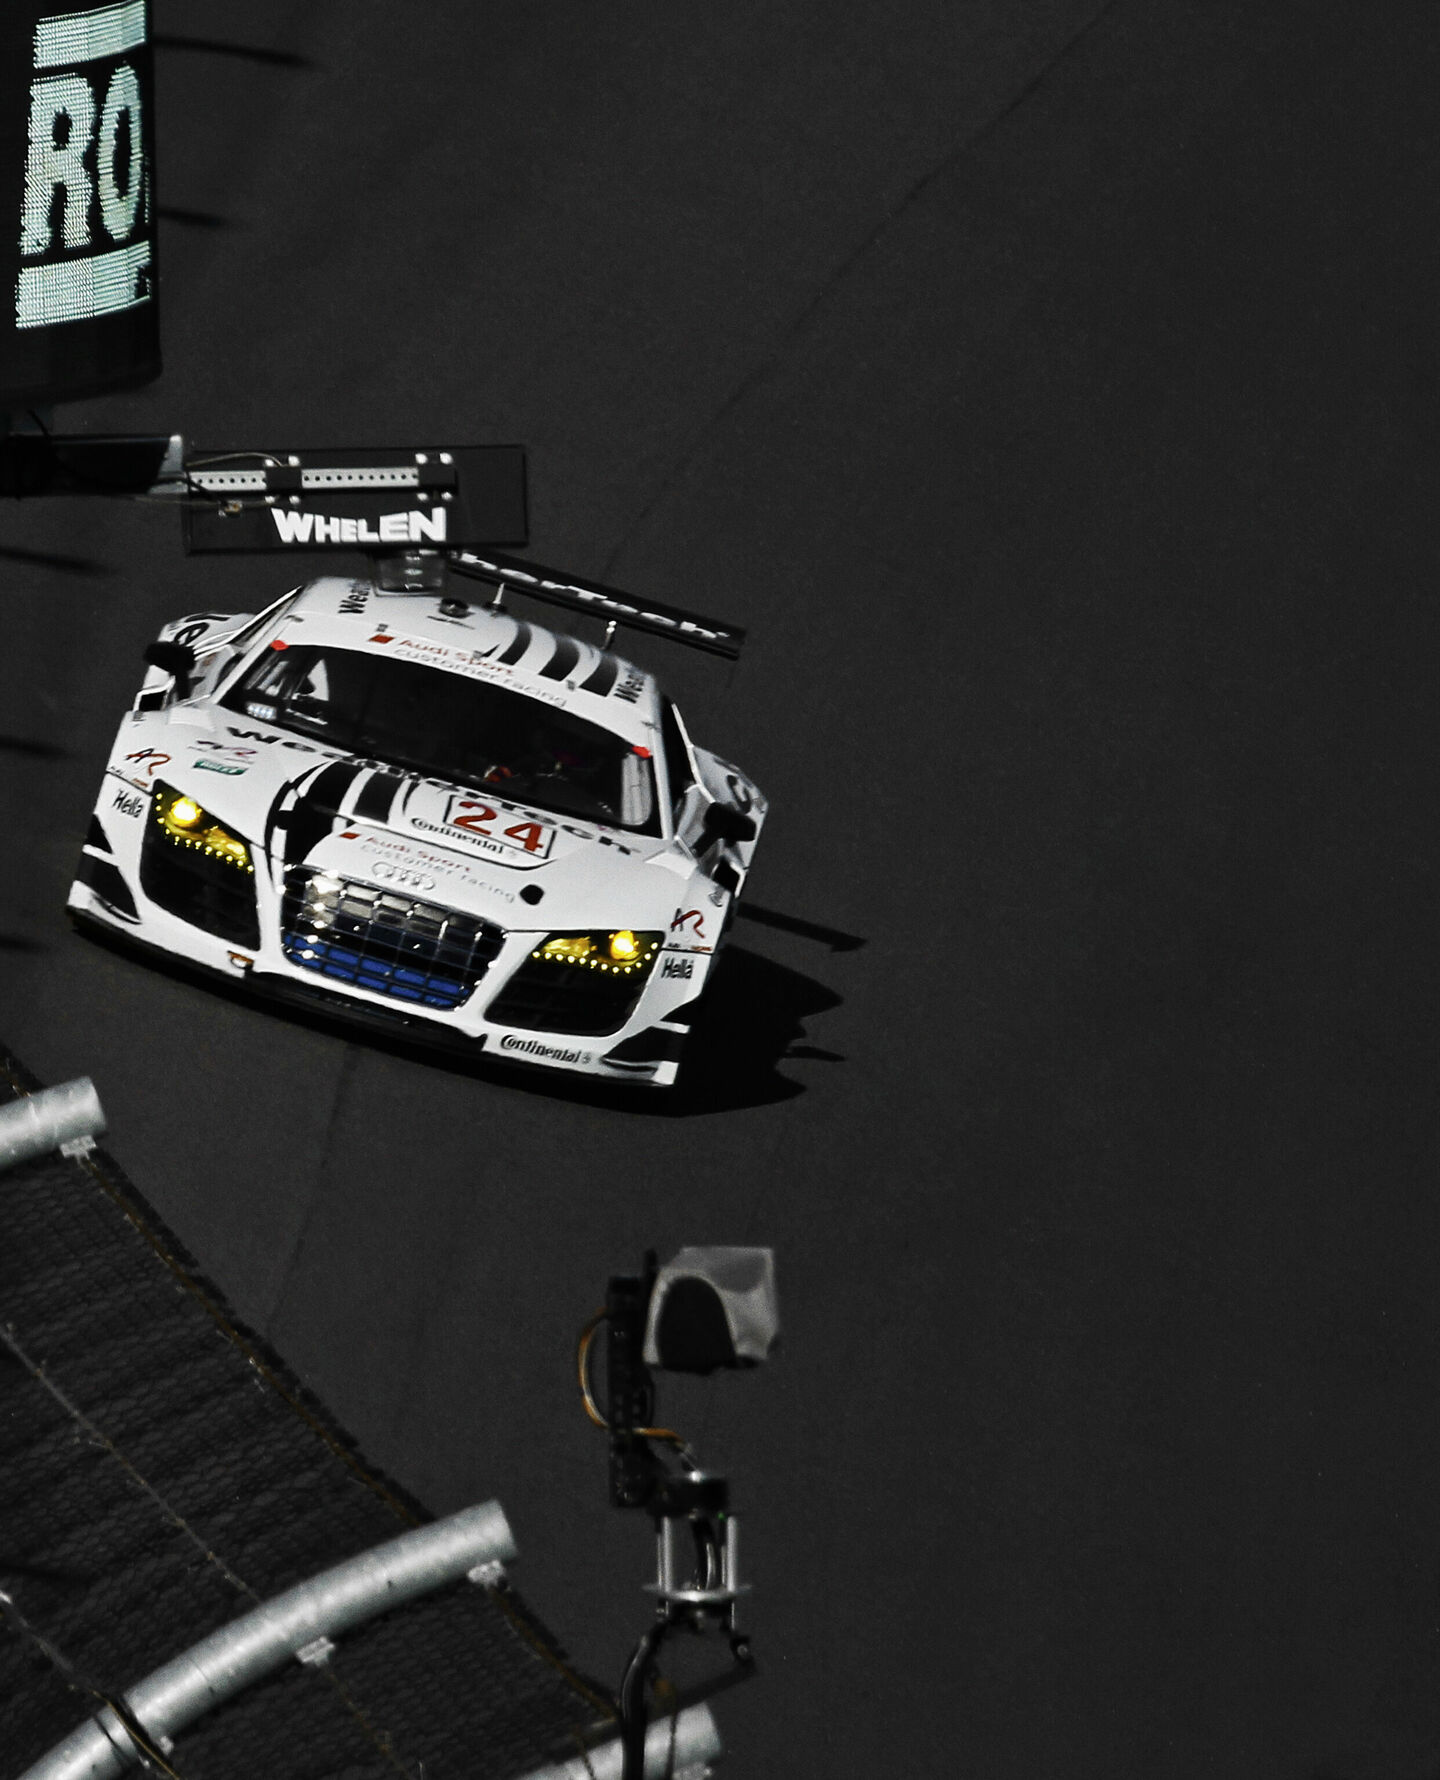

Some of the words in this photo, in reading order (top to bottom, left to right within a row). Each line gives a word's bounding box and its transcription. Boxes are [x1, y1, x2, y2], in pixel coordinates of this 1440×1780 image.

[18, 59, 150, 257] RO
[270, 506, 447, 544] WHELEN
[399, 638, 449, 657] Audi
[456, 651, 513, 677] Sport
[112, 788, 145, 818] Hella
[410, 816, 505, 855] Continental
[453, 800, 544, 853] 24
[366, 837, 410, 852] Audi
[417, 849, 471, 873] Sport
[660, 956, 694, 980] Hella
[500, 1034, 582, 1063] Continental
